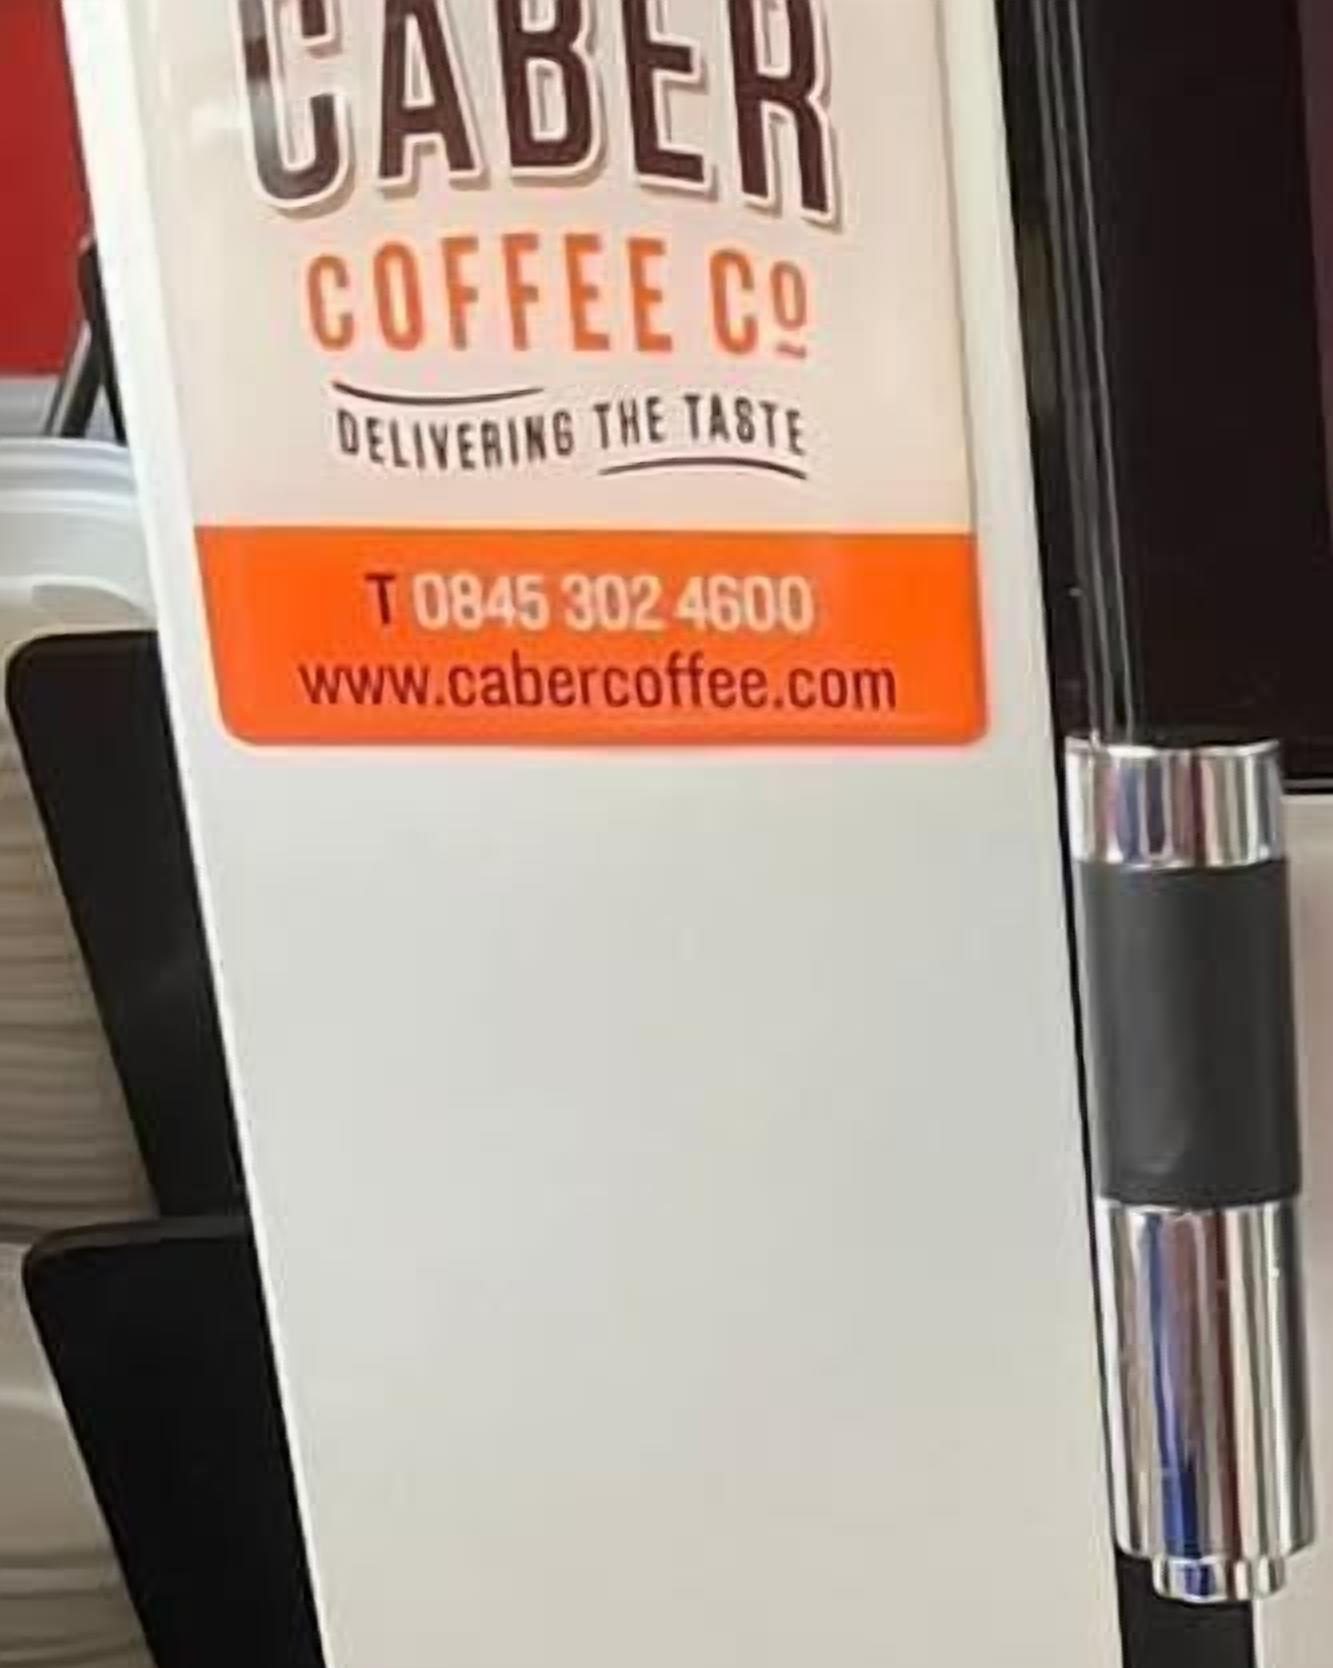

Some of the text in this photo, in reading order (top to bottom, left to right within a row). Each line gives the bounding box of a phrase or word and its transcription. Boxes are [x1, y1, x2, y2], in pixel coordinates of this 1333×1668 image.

[236, 0, 837, 221] CABER
[307, 233, 673, 351] COFFEE
[337, 395, 806, 470] DELIVERING THE TASTE
[364, 572, 817, 633] T 0845 302 4600
[297, 650, 898, 712] www.cabercoffee.com
